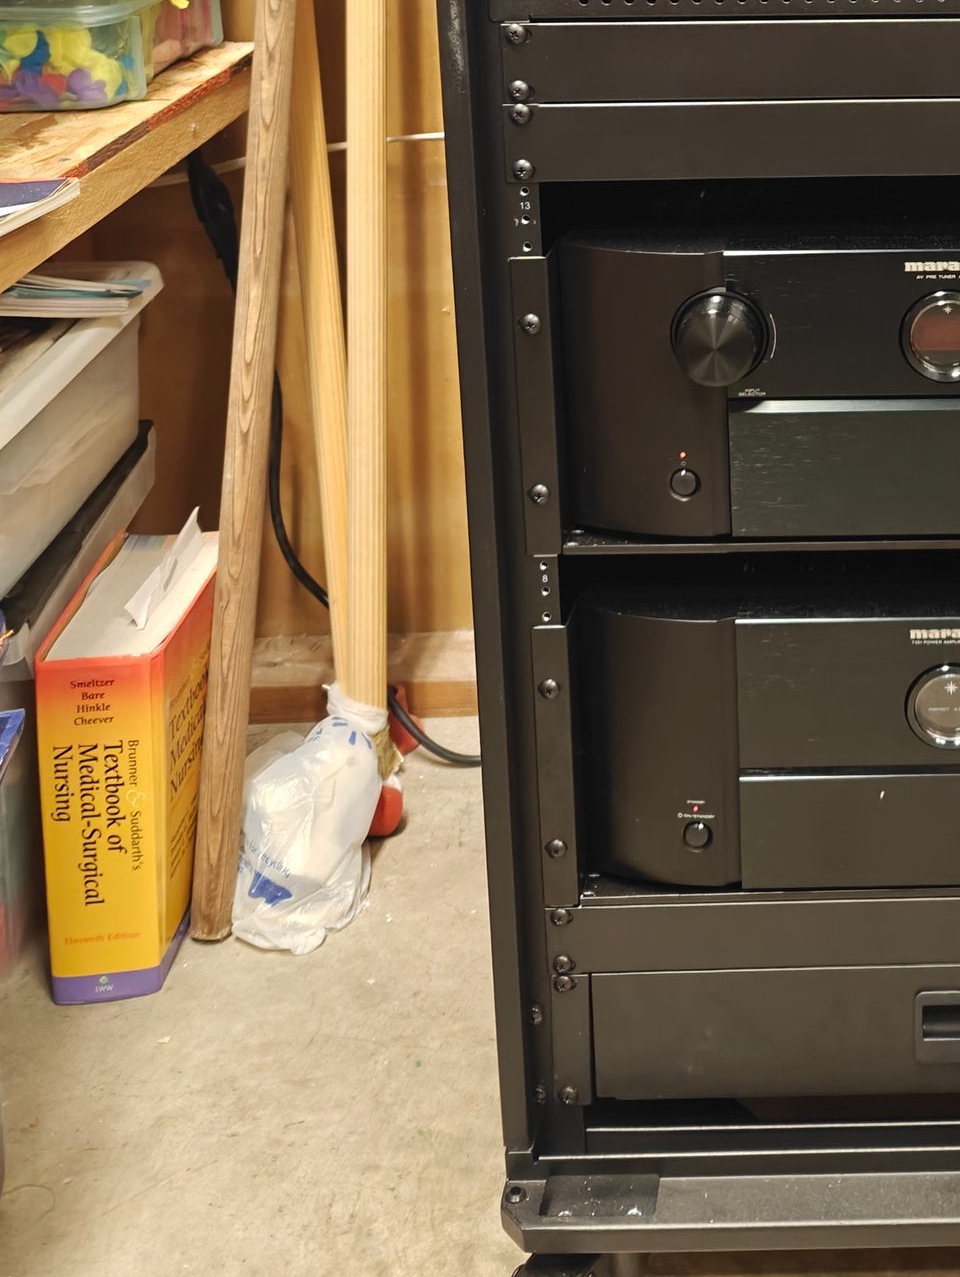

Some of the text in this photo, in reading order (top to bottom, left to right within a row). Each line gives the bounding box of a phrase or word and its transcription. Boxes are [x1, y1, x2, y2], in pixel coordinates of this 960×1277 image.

[70, 678, 115, 690] Smeltzer
[81, 691, 105, 701] Bare
[76, 703, 111, 714] Hinkle
[73, 715, 114, 726] Cheever
[51, 744, 75, 822] Nursing
[103, 739, 128, 855] Textbook of
[125, 739, 146, 871] Brunner & Suddarth's
[78, 743, 105, 907] Medical-Surgical
[64, 931, 142, 946] Eleventh Edition
